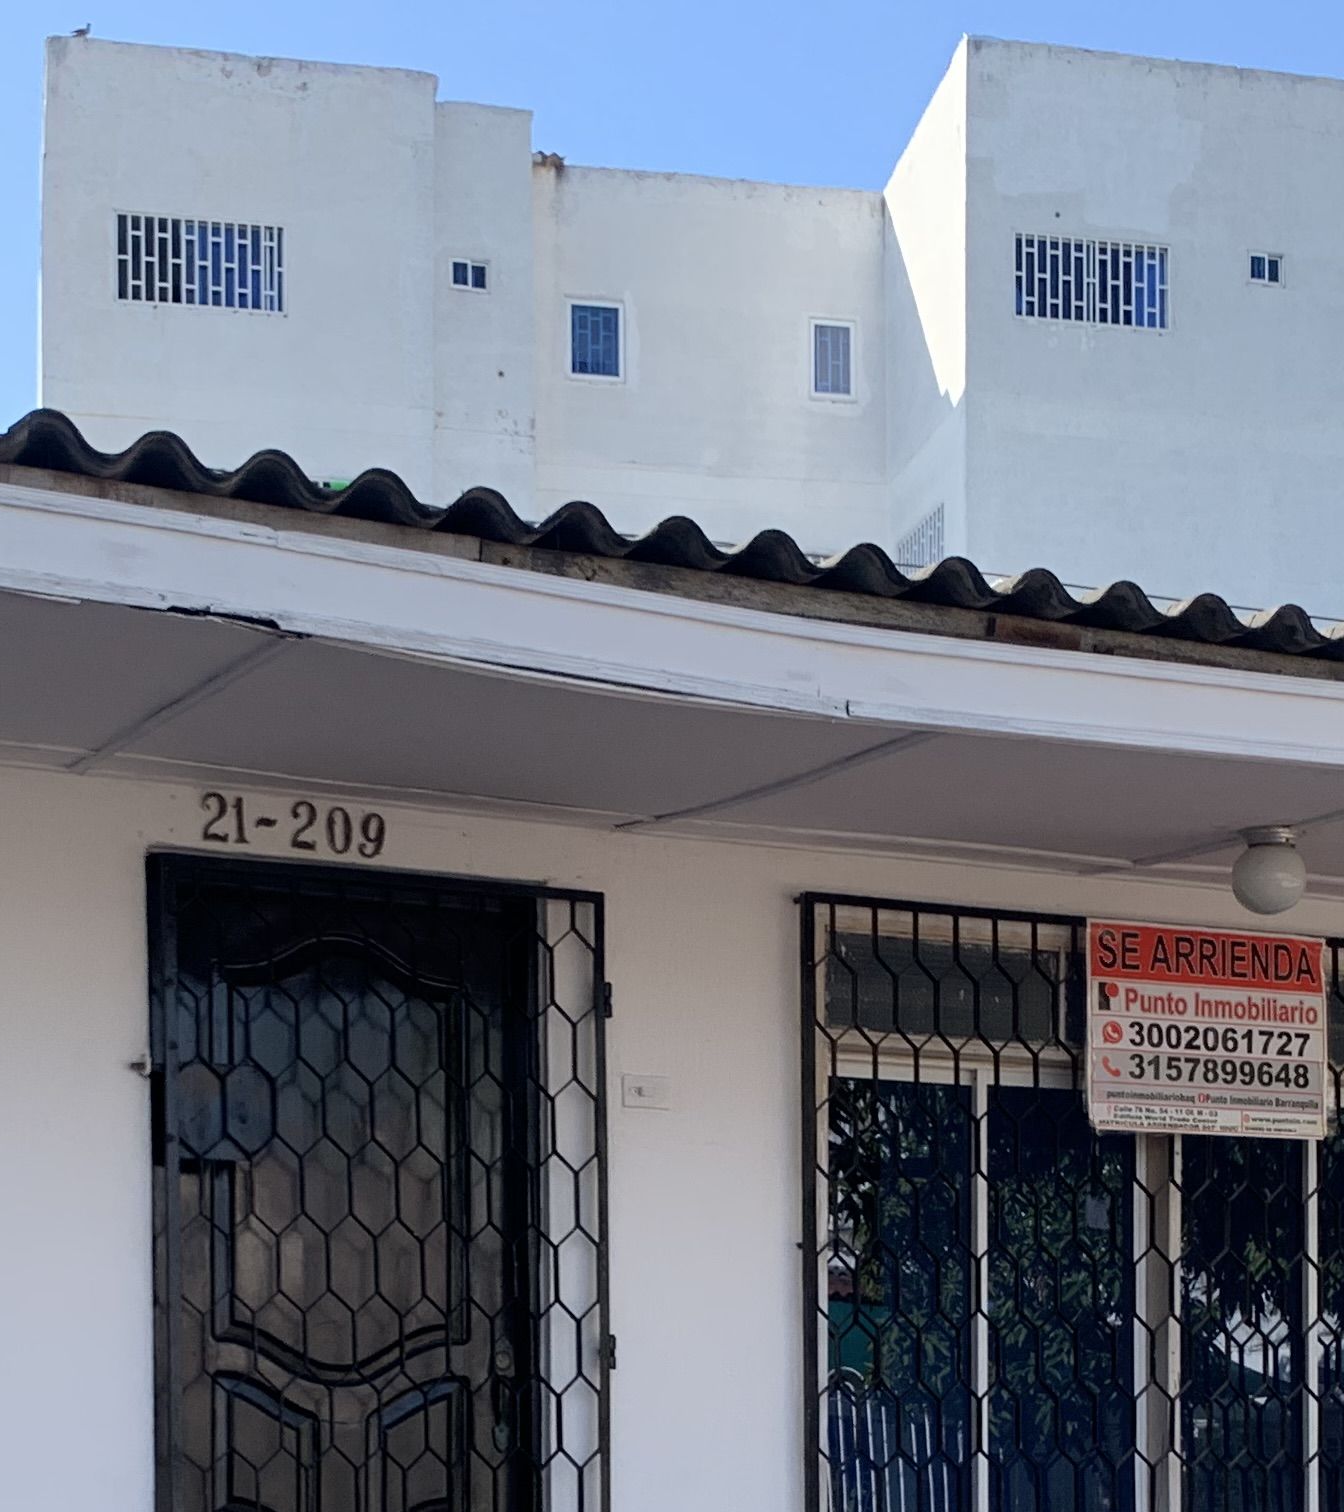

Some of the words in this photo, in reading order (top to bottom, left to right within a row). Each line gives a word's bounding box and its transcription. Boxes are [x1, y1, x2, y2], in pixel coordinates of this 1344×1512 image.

[201, 792, 386, 859] 21-209
[1098, 930, 1140, 970] SE
[1150, 935, 1316, 984] ARRIENDA
[1125, 988, 1188, 1016] Punto
[1194, 992, 1318, 1025] Inmobiliario
[1129, 1021, 1310, 1057] 3002061727
[1129, 1054, 1309, 1088] 3157899648
